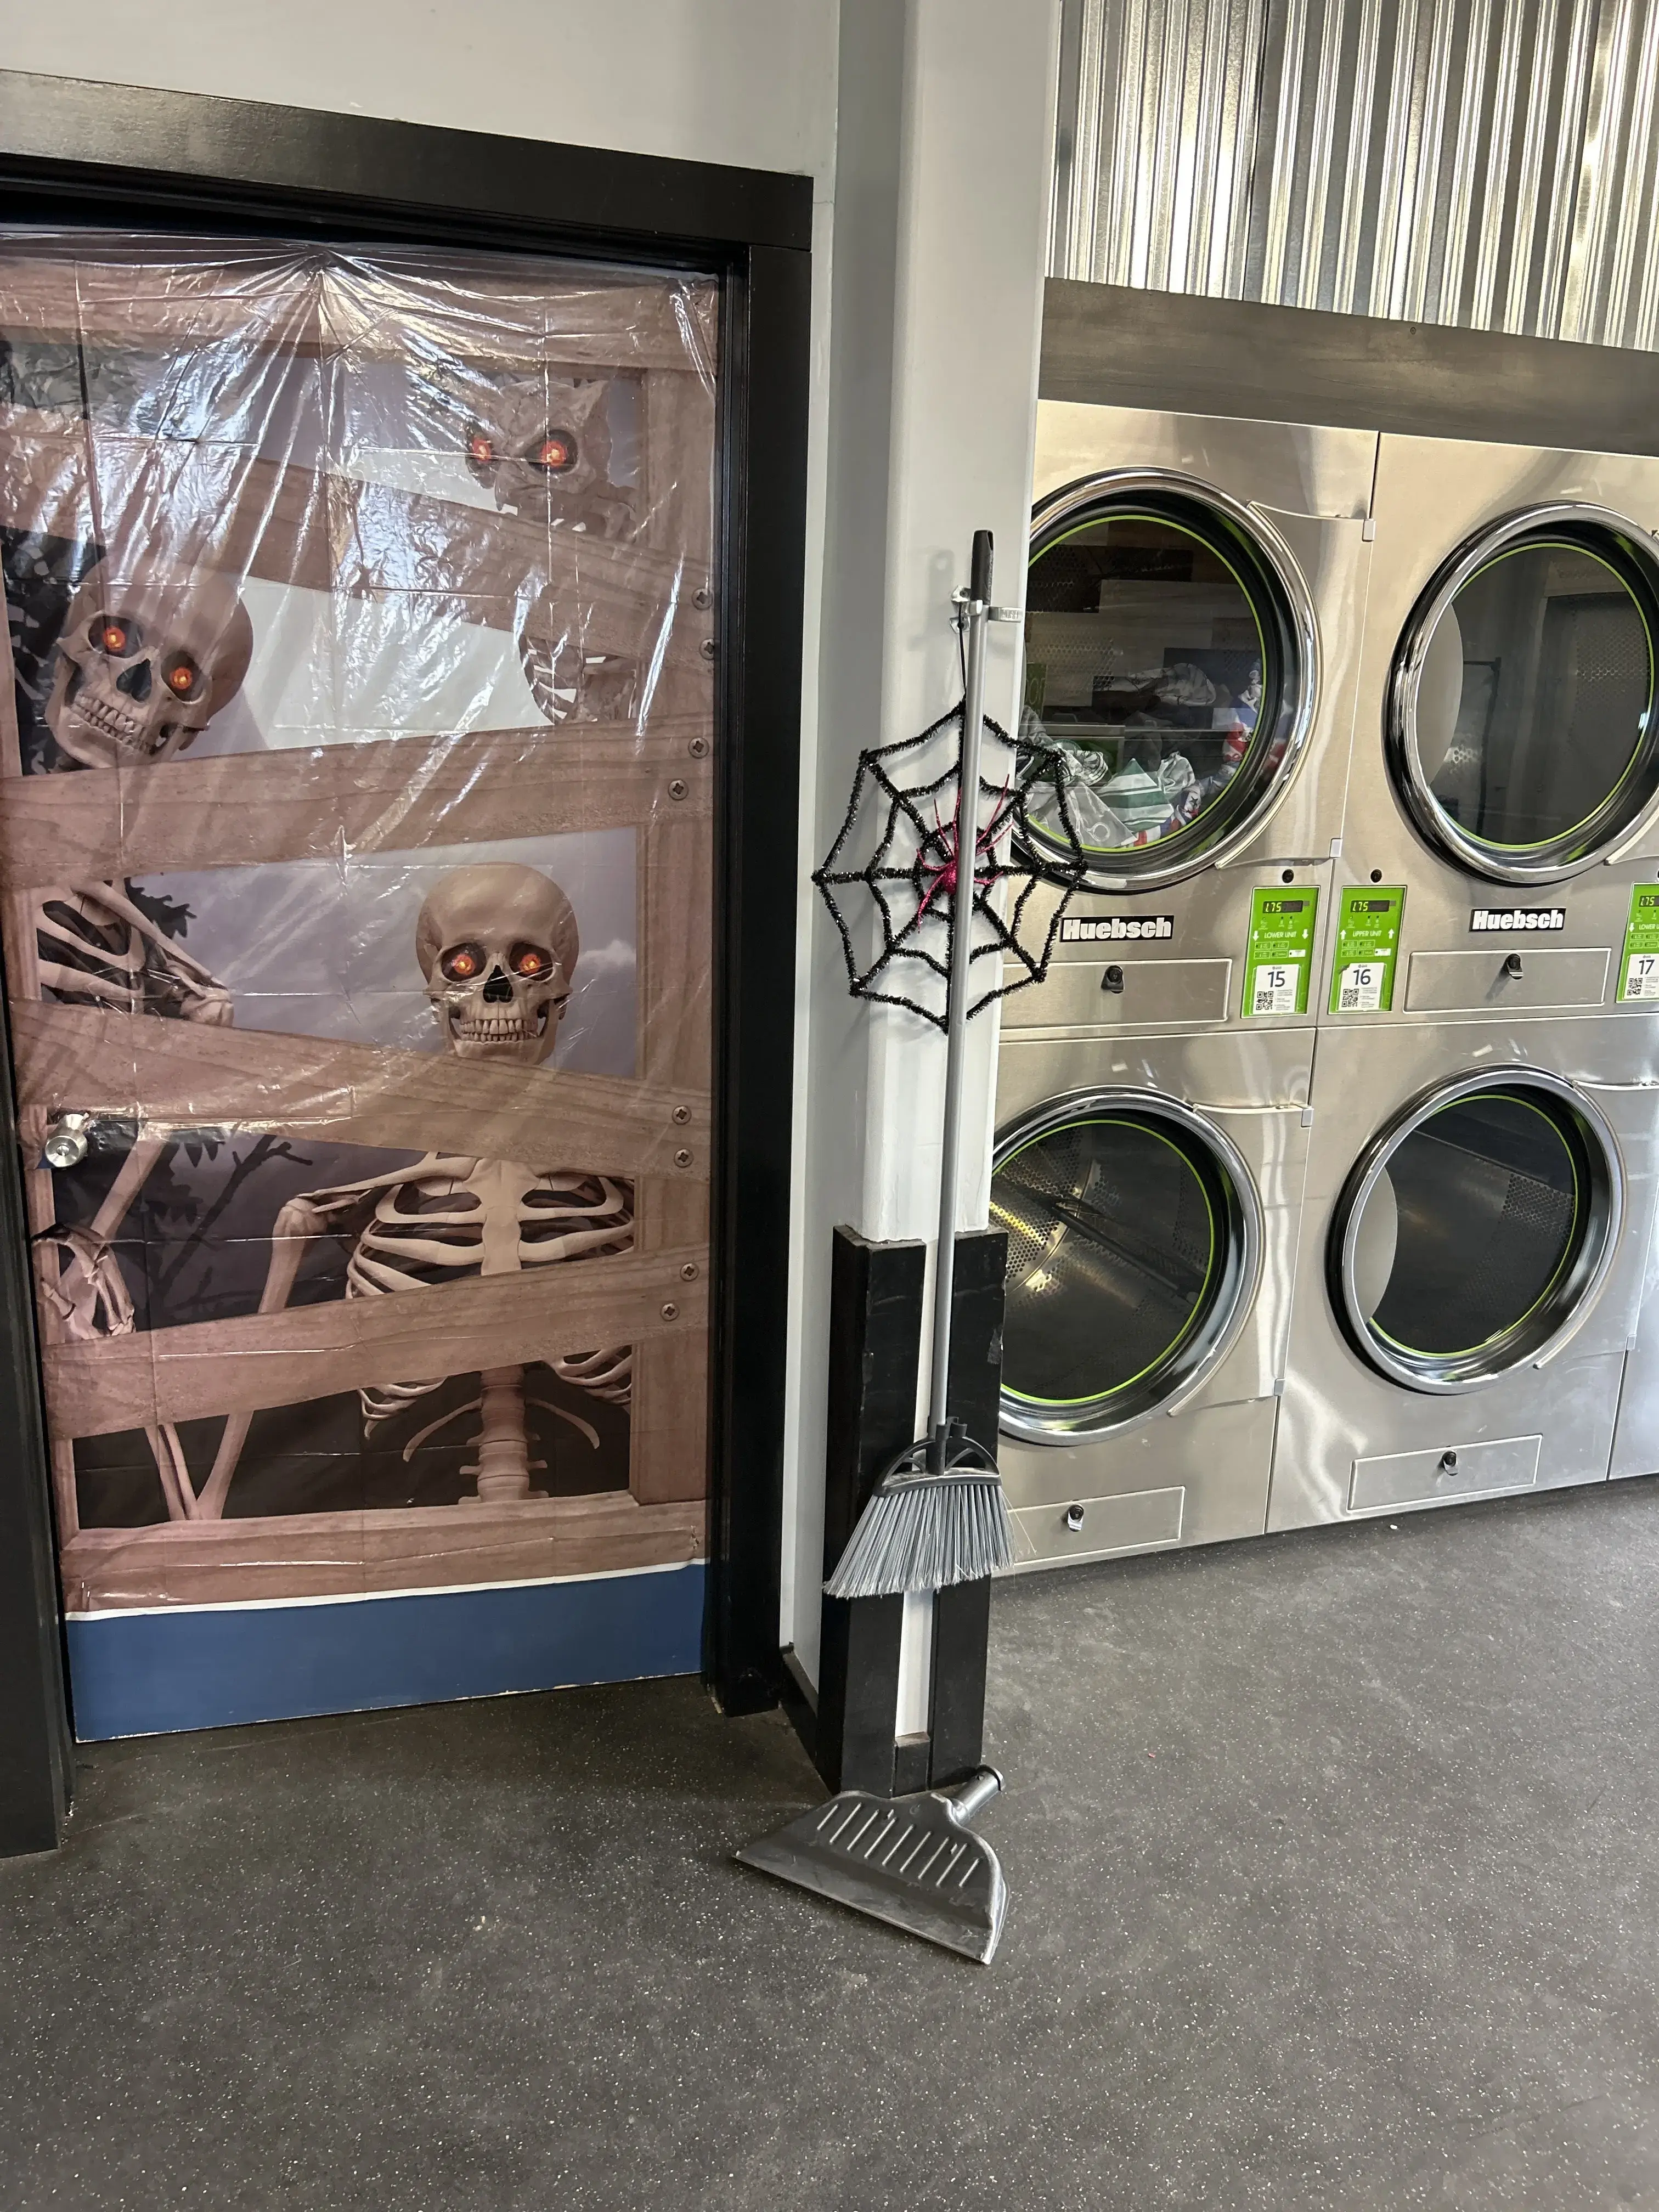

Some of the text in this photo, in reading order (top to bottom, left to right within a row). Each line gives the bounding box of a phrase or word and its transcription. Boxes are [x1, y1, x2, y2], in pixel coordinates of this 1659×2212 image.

[1063, 918, 1171, 939] Huebsch
[1472, 910, 1563, 929] Huebsch
[1639, 959, 1655, 975] 17
[1267, 970, 1285, 988] 15
[1353, 969, 1371, 985] 16
